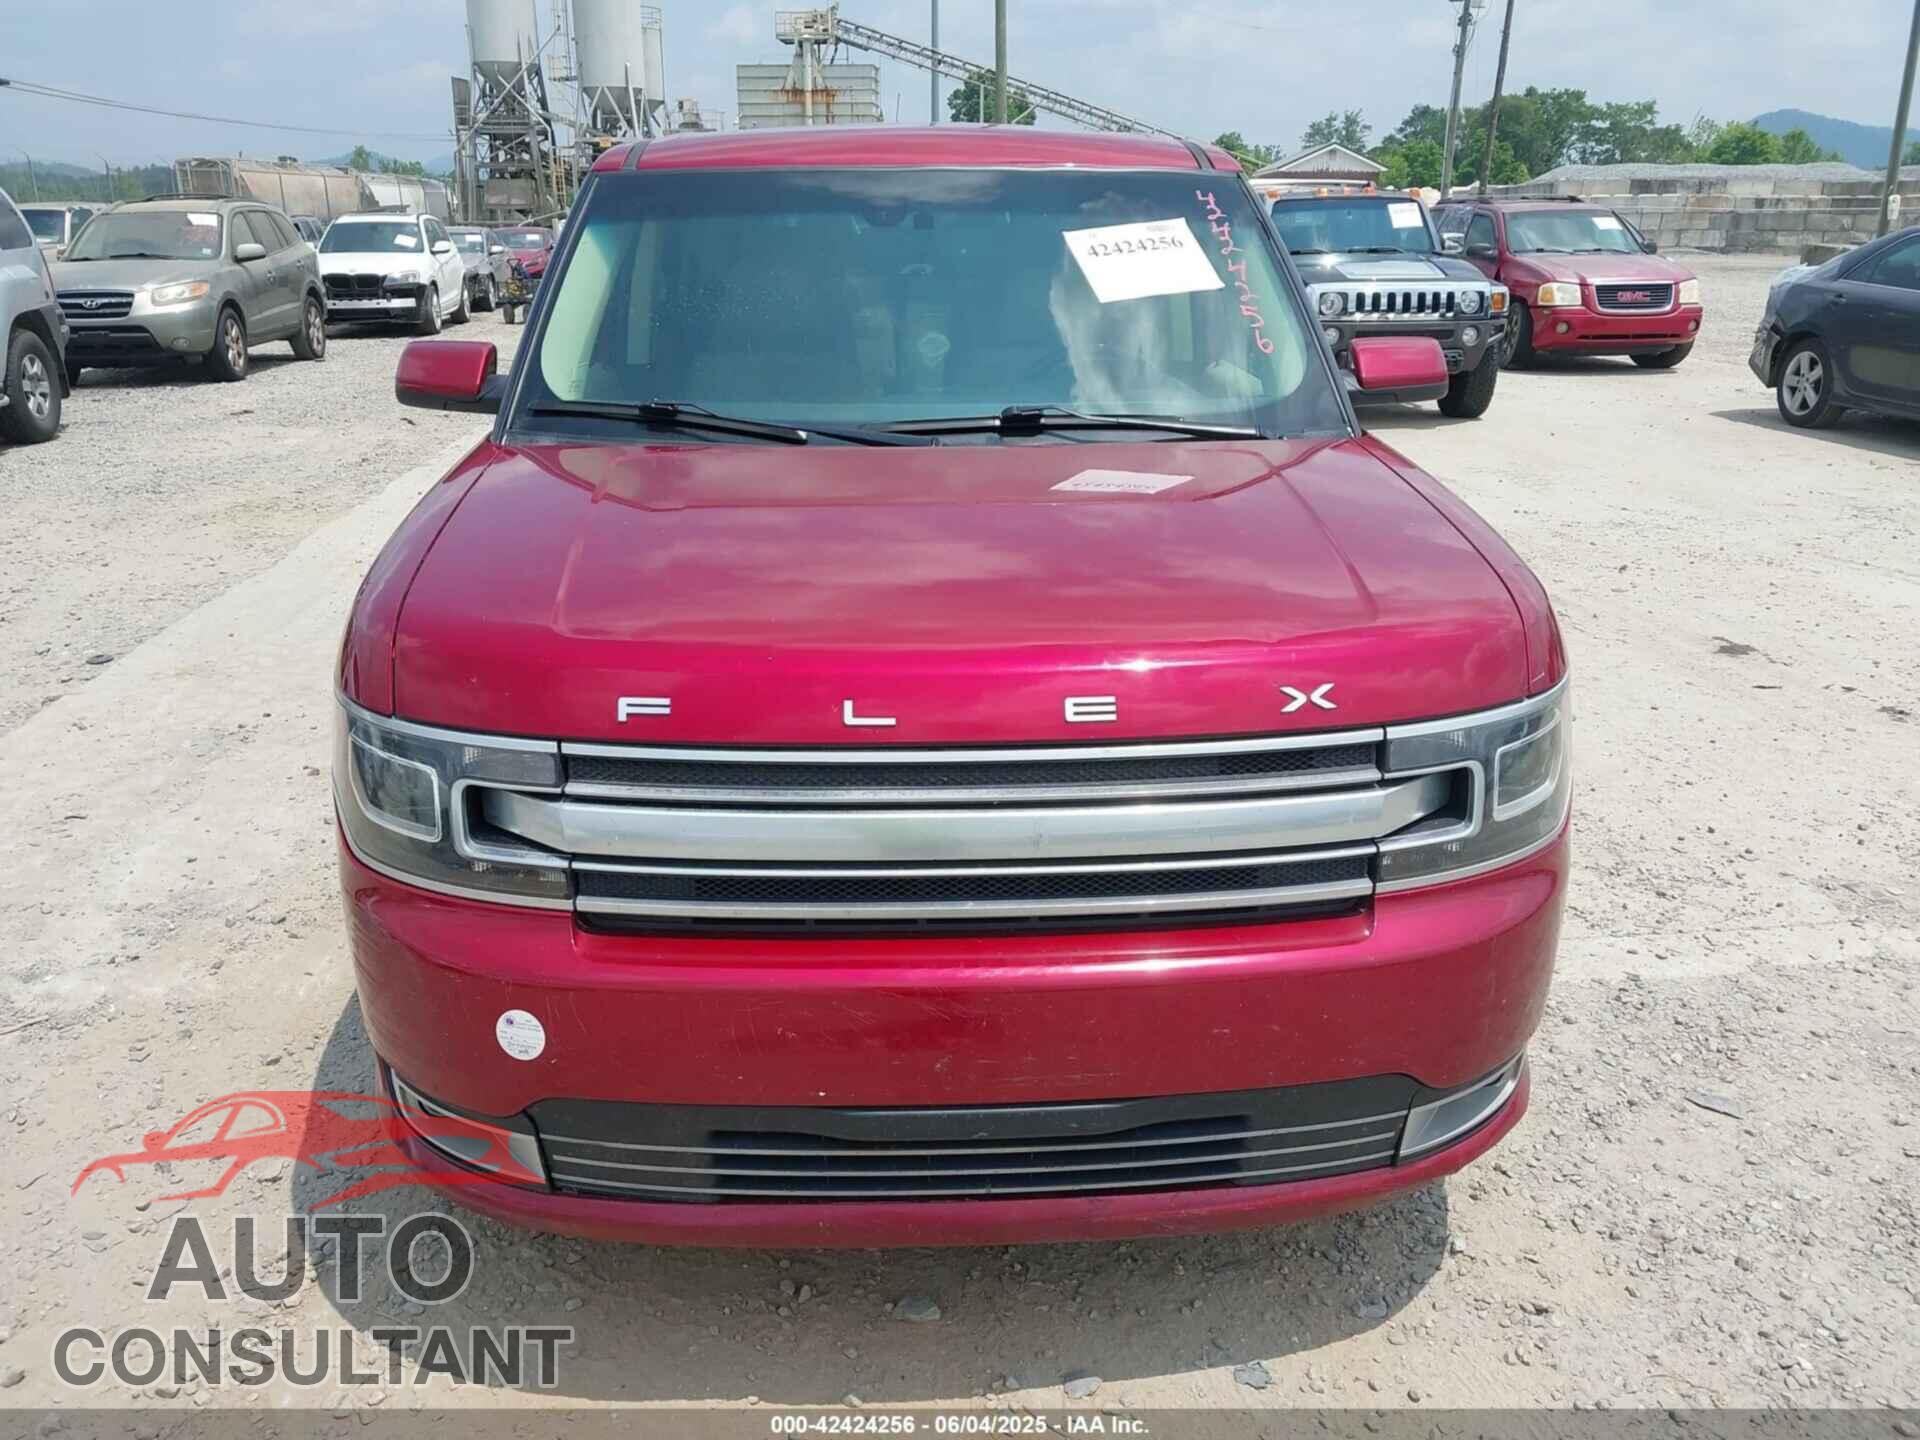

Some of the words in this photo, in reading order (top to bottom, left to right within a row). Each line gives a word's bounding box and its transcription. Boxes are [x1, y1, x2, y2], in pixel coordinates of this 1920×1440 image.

[1087, 234, 1184, 258] 42424256
[1195, 189, 1274, 354] 42424256
[1616, 291, 1650, 303] GMC
[617, 682, 1338, 726] FLEX
